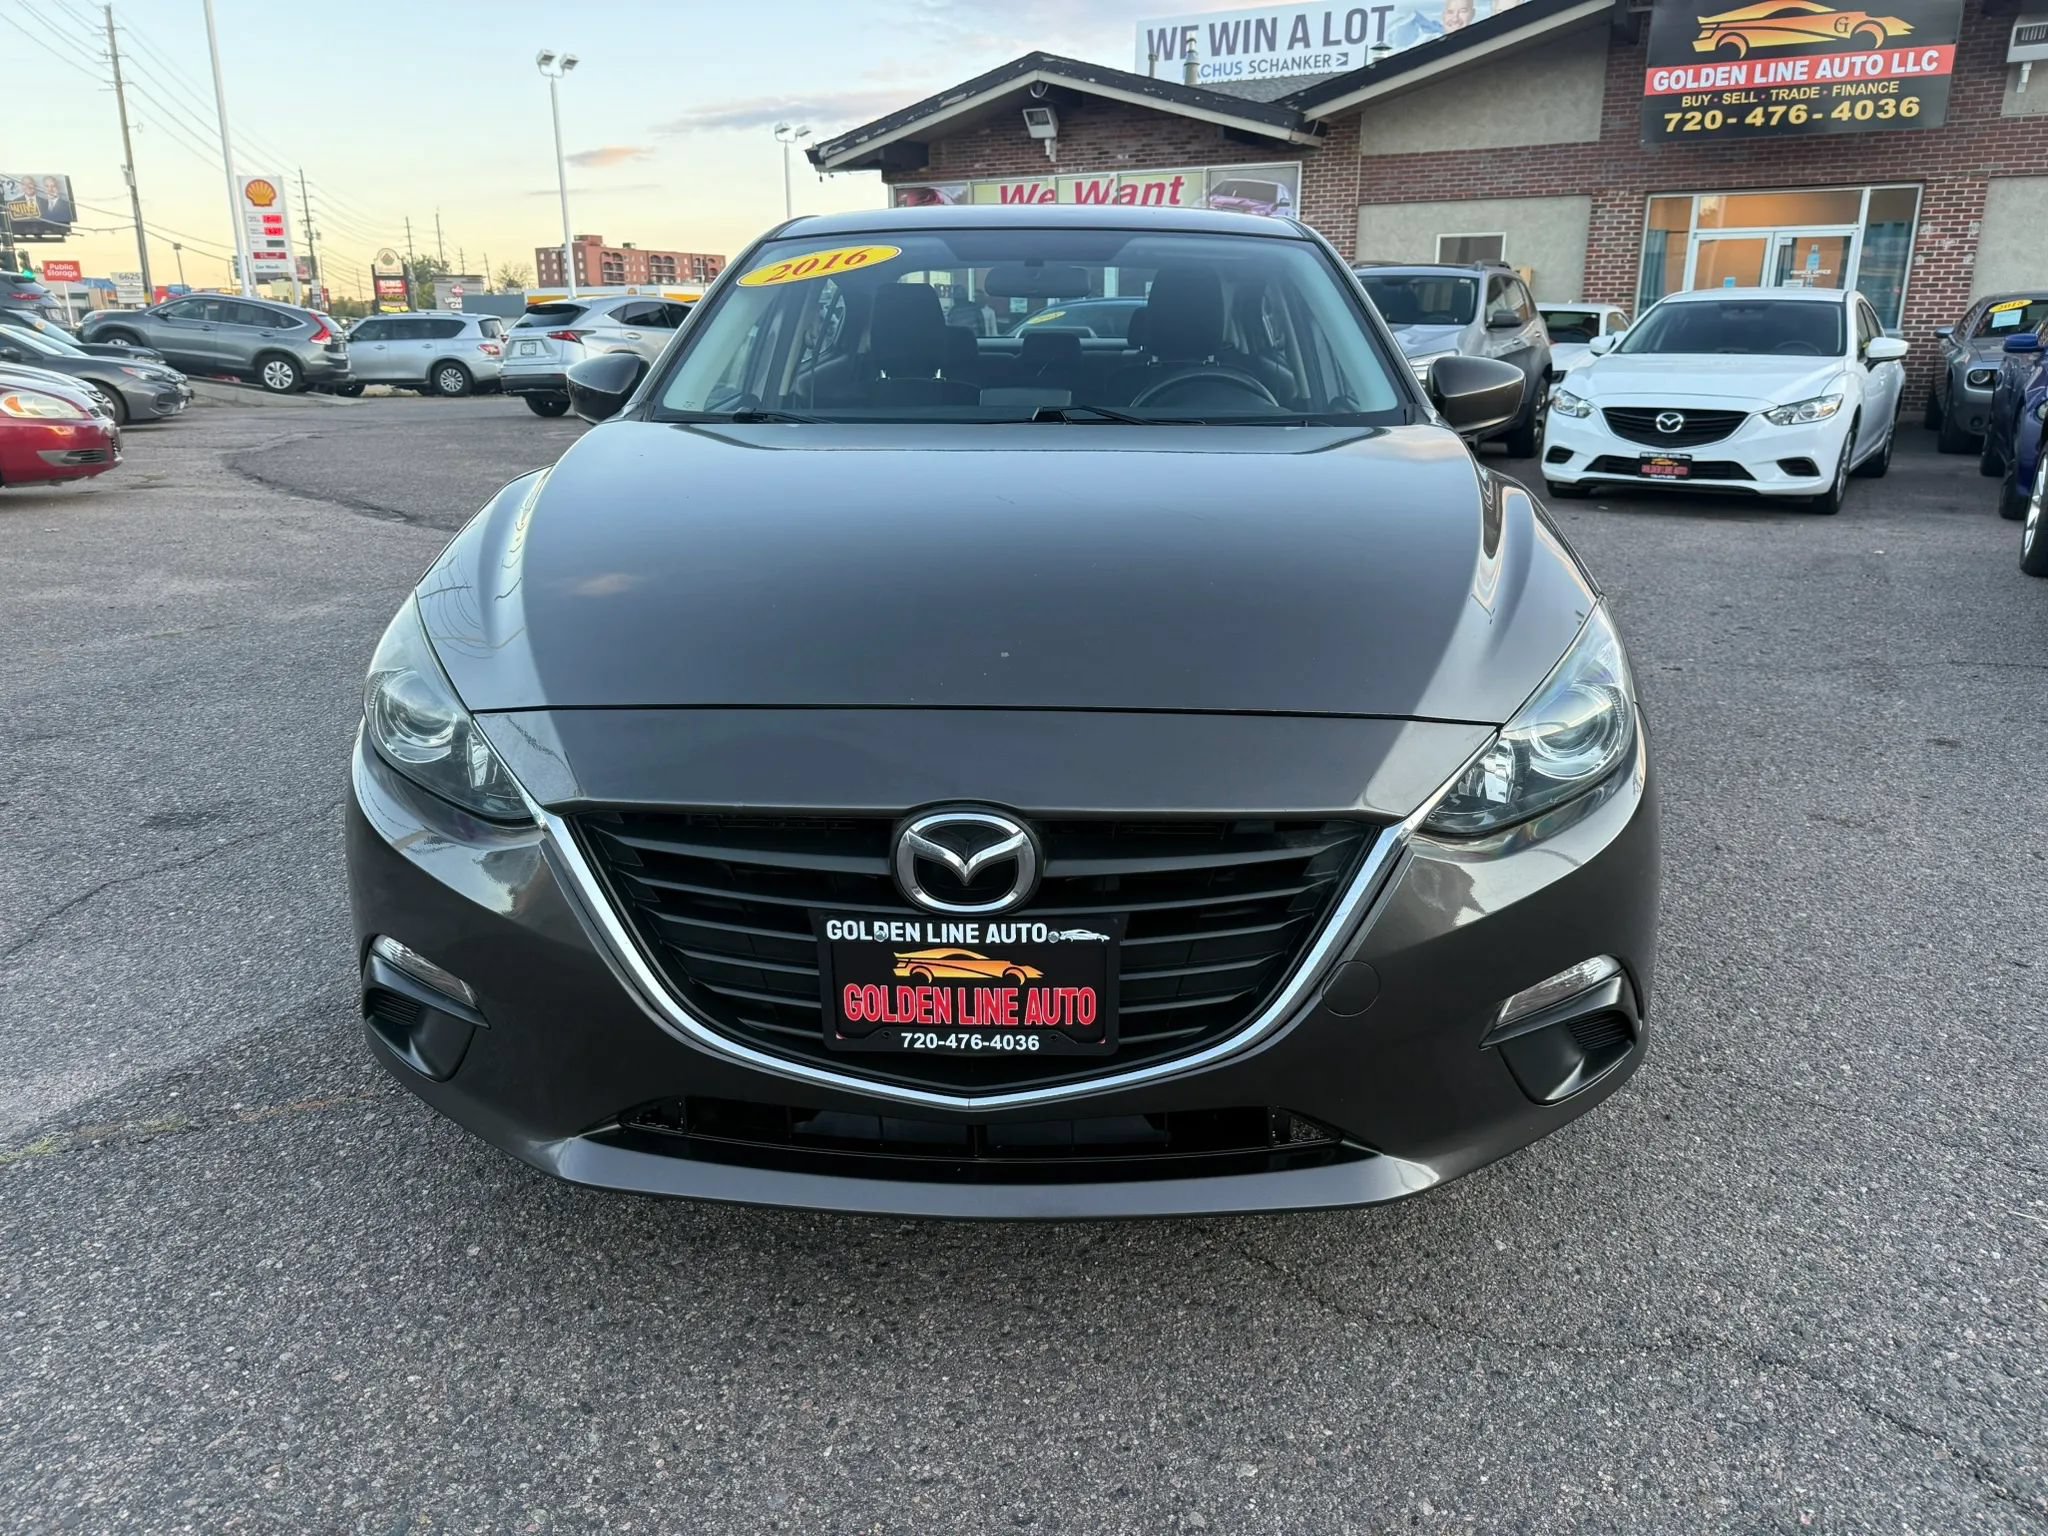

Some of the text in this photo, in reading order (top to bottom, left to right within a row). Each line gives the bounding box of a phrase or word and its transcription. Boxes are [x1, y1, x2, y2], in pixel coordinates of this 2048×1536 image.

[1208, 17, 1278, 57] WIN
[1287, 14, 1312, 51] A
[1322, 5, 1395, 47] LOT
[1196, 61, 1243, 79] CHUS
[1247, 54, 1332, 75] SCHANKER
[1653, 49, 1940, 92] GOLDEN LINE AUTO LLC
[1681, 81, 1900, 108] BUY SELL TRADE FINANCE
[1000, 175, 1185, 207] We Want
[47, 269, 78, 278] Storage
[118, 272, 141, 280] 6625
[763, 248, 873, 283] 2016
[826, 920, 1048, 944] GOLDEN LINE AUTO
[843, 983, 1097, 1026] GOLDEN LINE AUTO
[901, 1032, 1040, 1051] 720-476-4036
